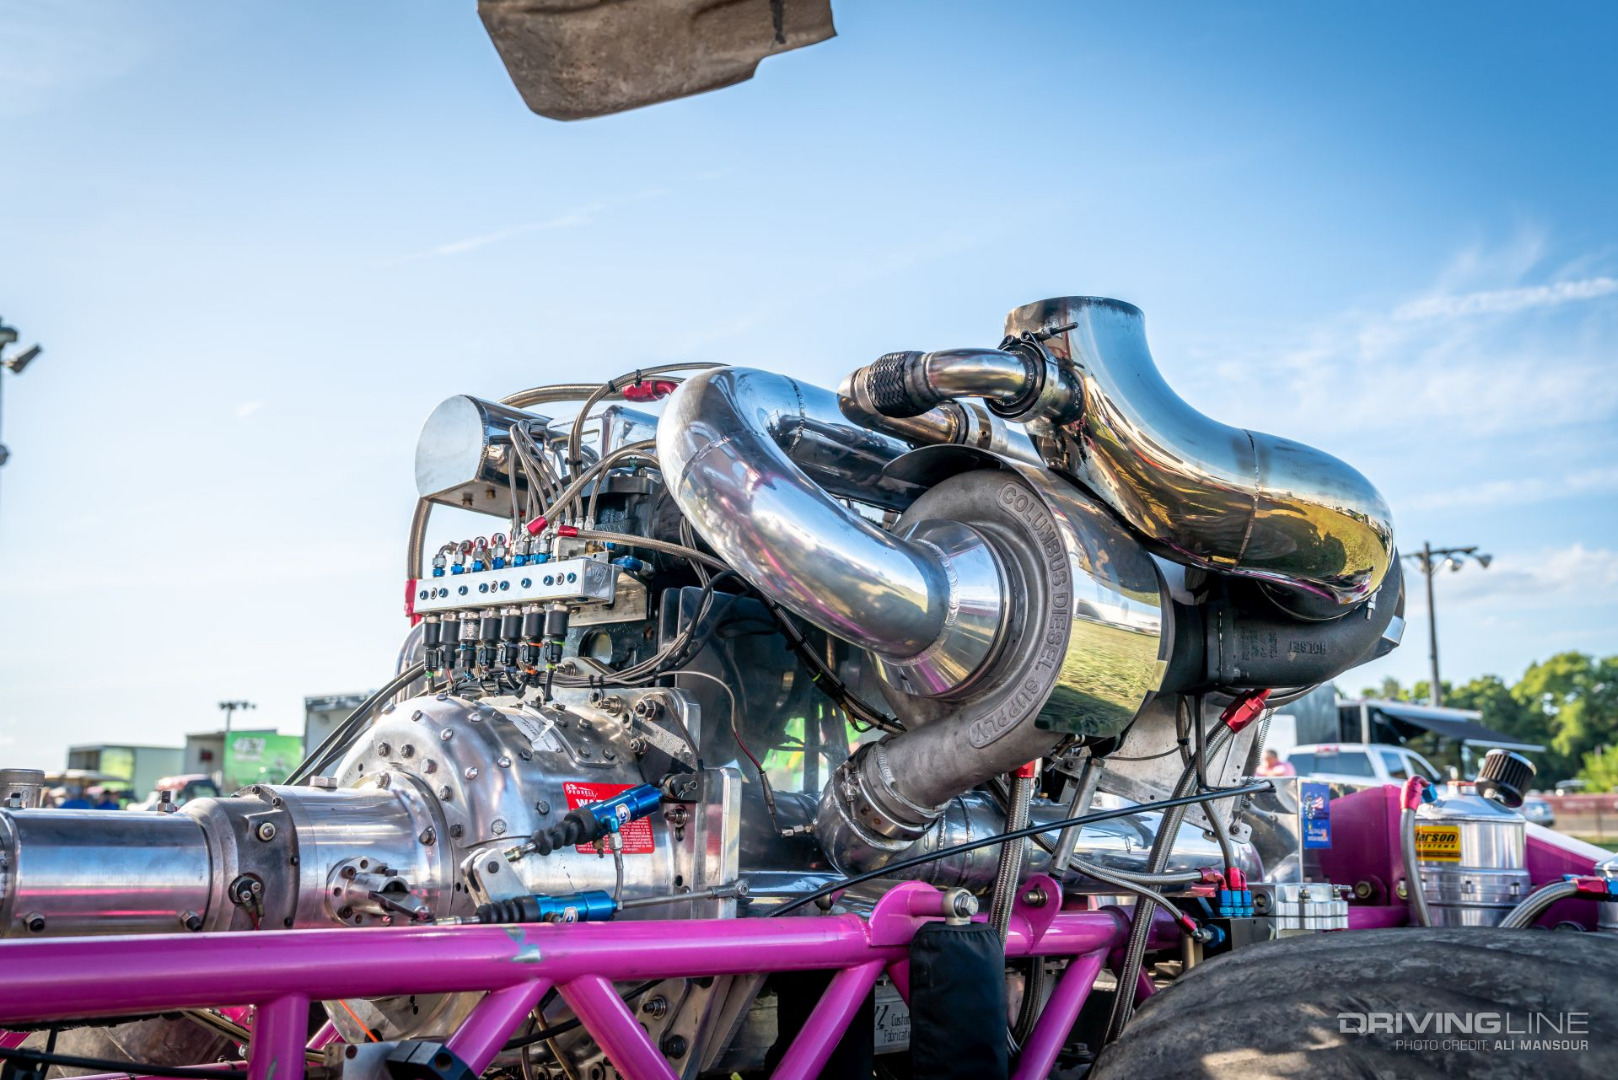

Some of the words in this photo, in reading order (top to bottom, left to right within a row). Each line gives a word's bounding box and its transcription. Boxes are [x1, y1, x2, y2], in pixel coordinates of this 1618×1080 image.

[1001, 487, 1069, 586] COLUMBUS
[1036, 592, 1069, 673] DIESEL
[1288, 641, 1327, 655] HOLSET
[973, 680, 1042, 743] SUPPLY
